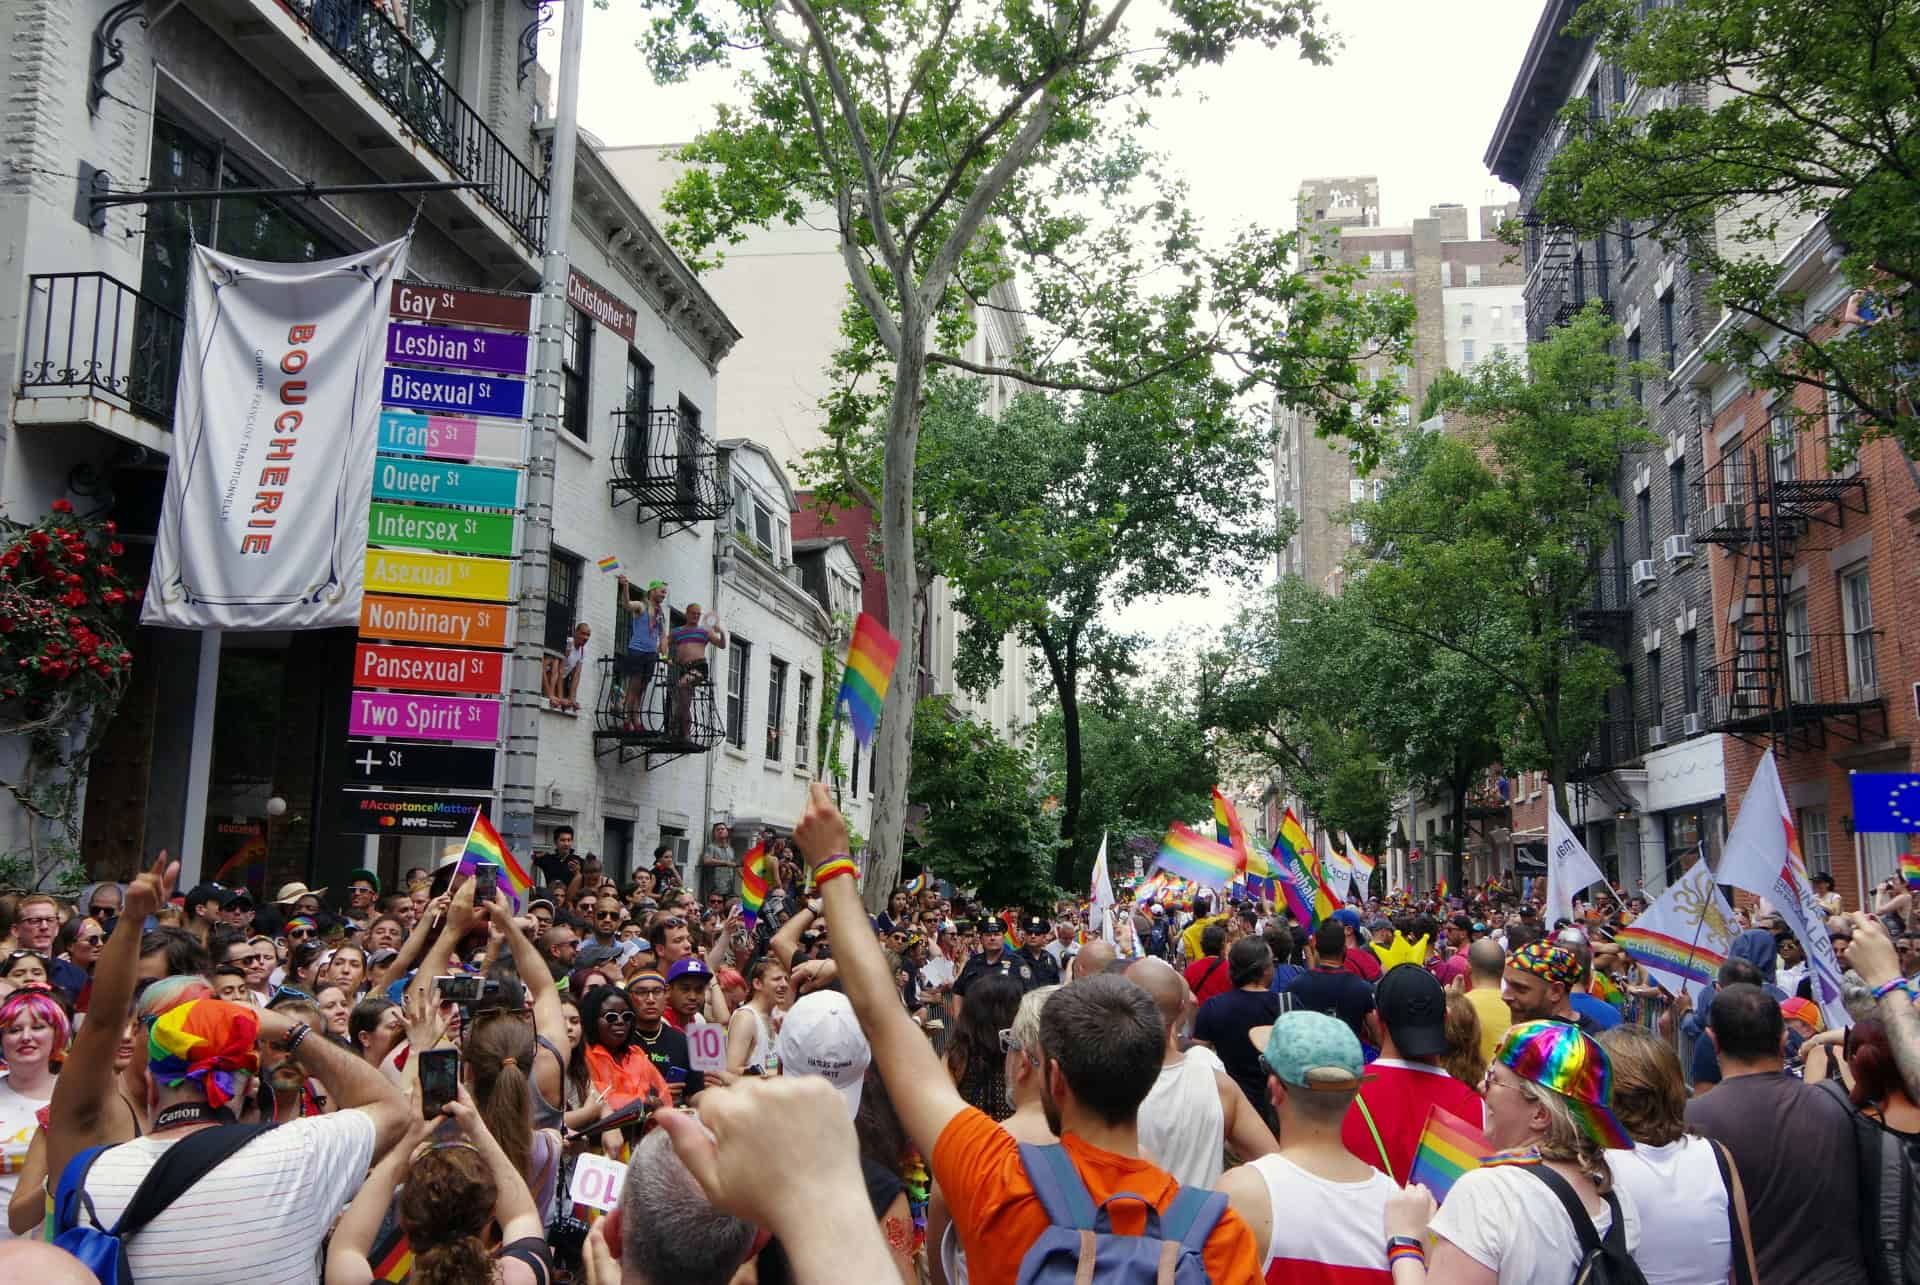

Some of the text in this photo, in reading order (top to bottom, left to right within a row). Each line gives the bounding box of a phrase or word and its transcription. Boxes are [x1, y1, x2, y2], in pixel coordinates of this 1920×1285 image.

[400, 288, 435, 319] Gay
[442, 293, 455, 308] St
[569, 273, 624, 329] Christopher
[395, 330, 486, 361] Lesbian St
[391, 374, 491, 405] Bisexual St
[240, 325, 316, 555] BOUCHERIE
[387, 420, 458, 447] Trans St
[383, 465, 459, 493] Queer St
[377, 511, 477, 541] Intersex St
[373, 558, 471, 586] Asexual St
[369, 604, 490, 641] Nonbinary St
[364, 651, 484, 682] Pansexual St
[362, 700, 481, 735] Two Spirit St
[388, 750, 402, 767] St
[402, 817, 428, 827] NYC
[691, 1028, 719, 1058] 10
[159, 1108, 200, 1123] Canon
